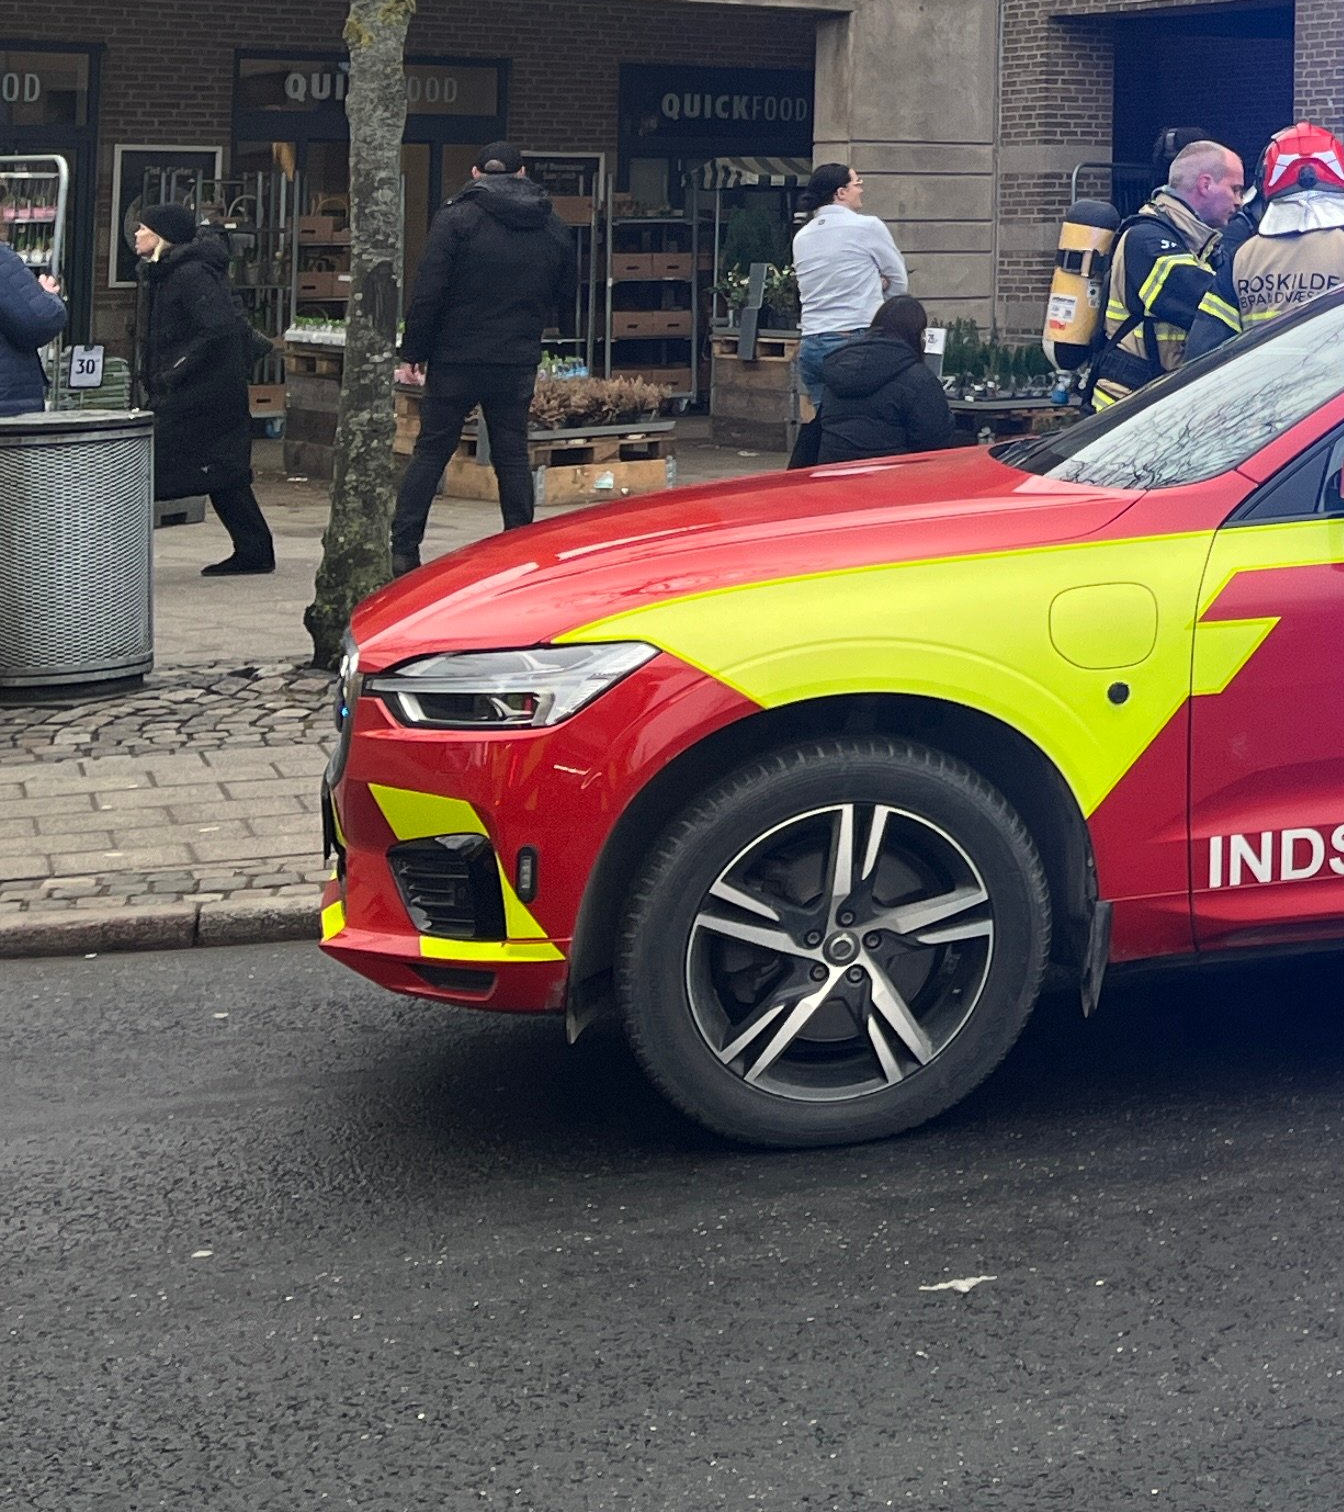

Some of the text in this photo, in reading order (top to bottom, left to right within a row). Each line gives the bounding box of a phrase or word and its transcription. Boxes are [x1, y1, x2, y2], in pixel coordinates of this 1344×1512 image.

[284, 72, 458, 103] QUIOOD
[661, 92, 808, 122] QUICKFOOD
[75, 358, 96, 375] 30
